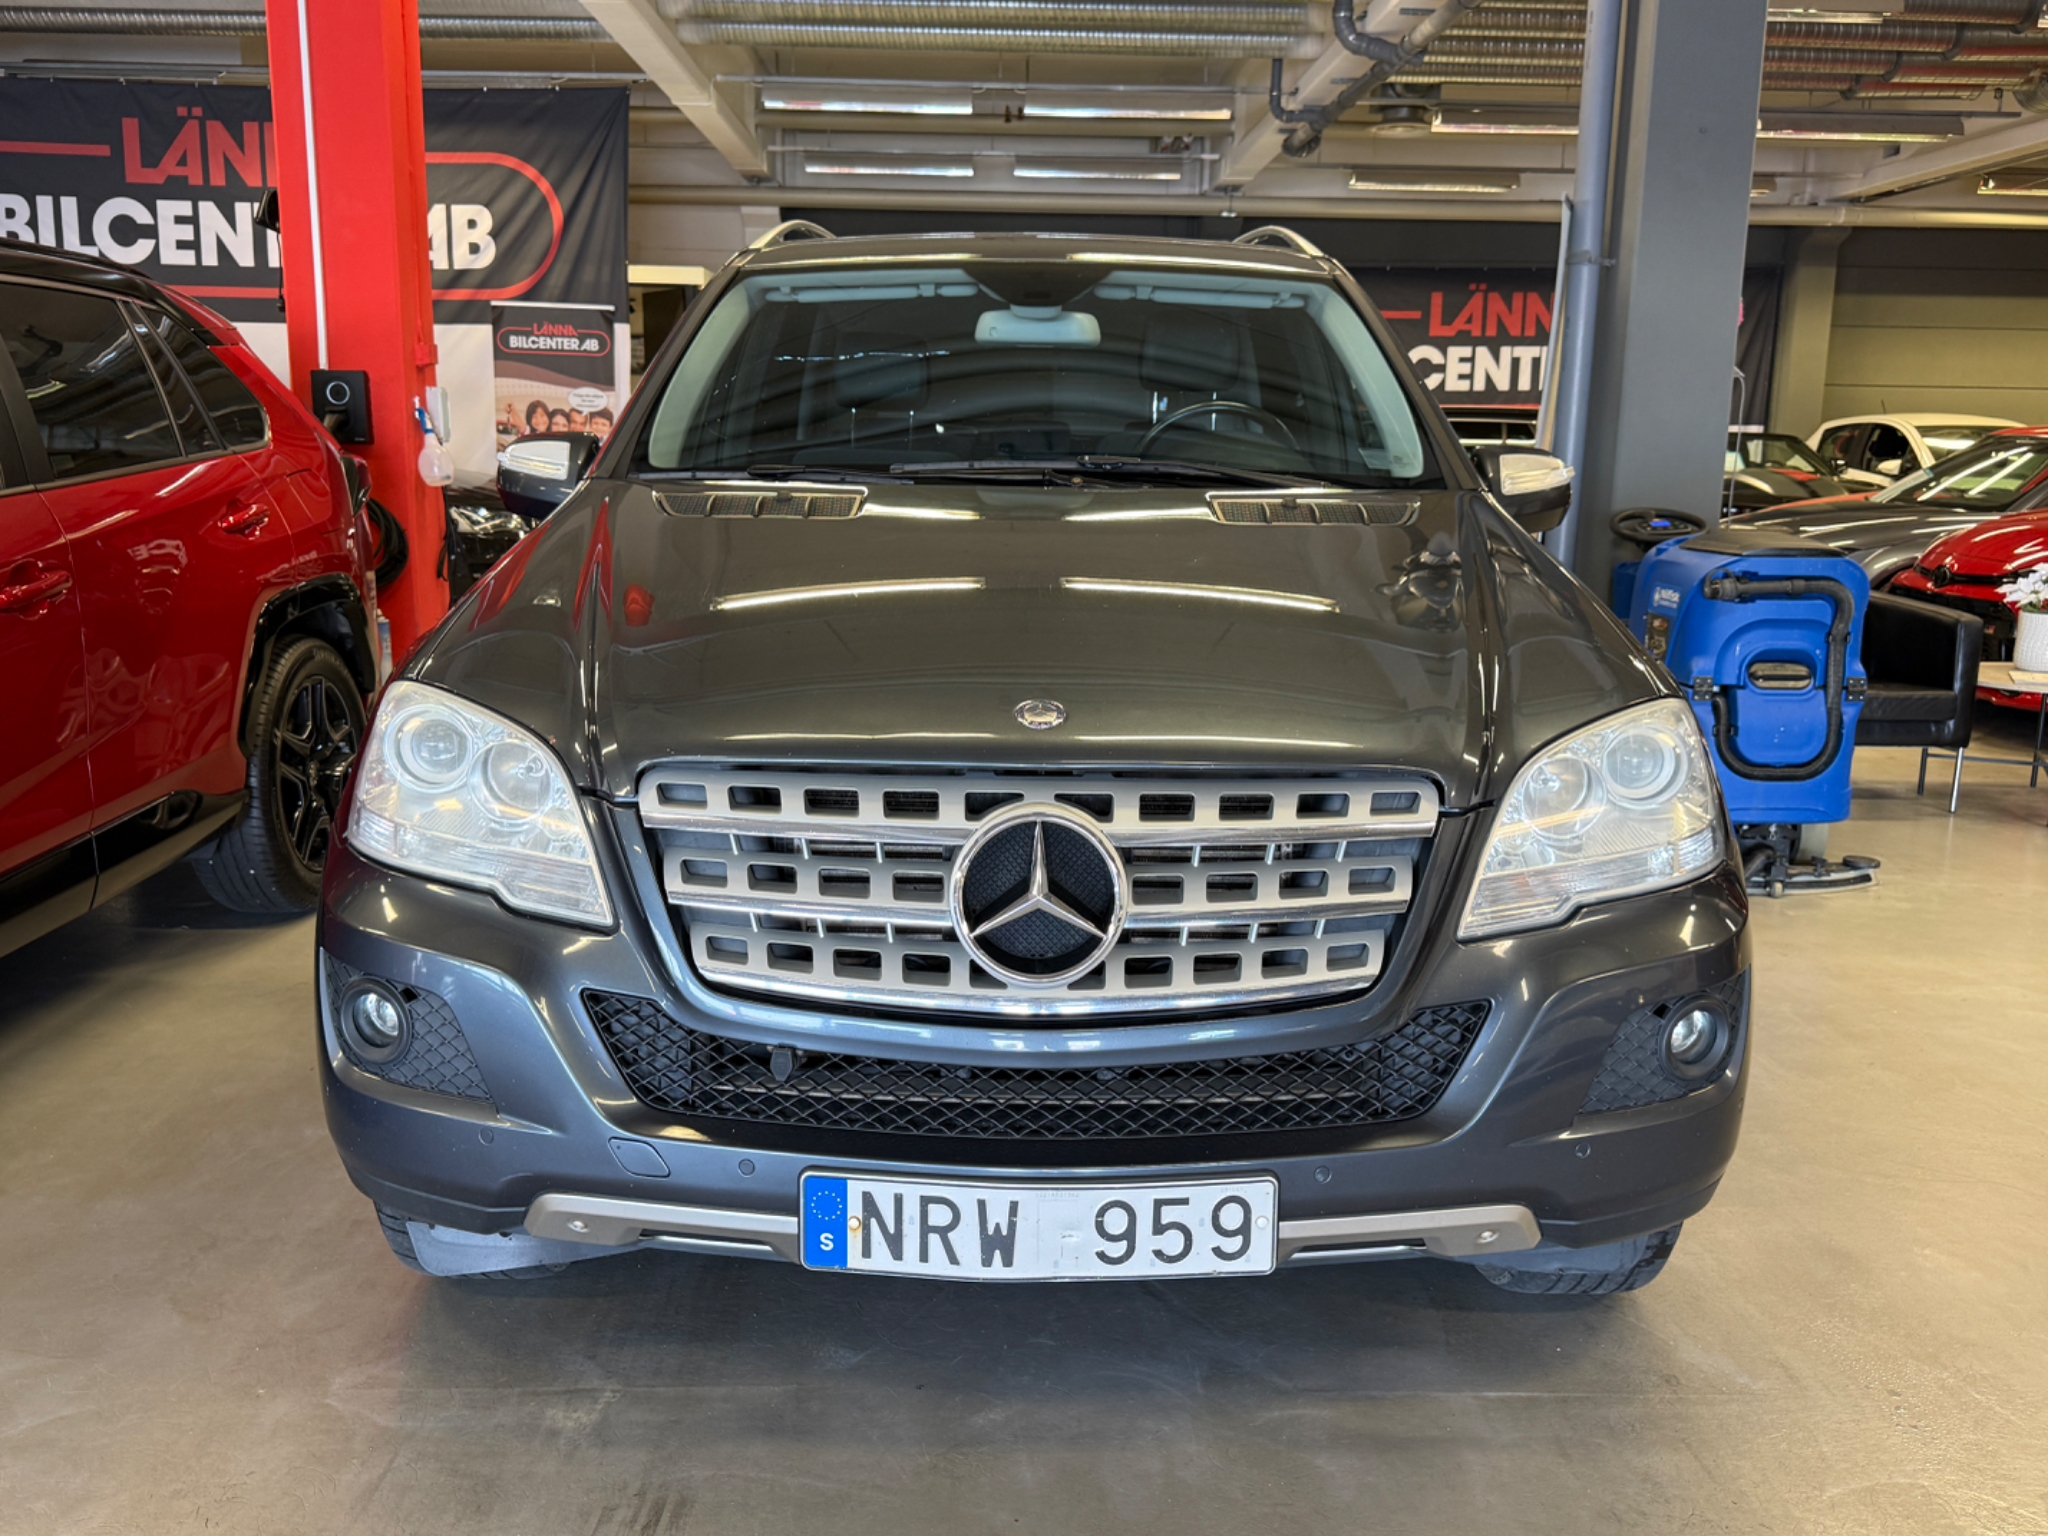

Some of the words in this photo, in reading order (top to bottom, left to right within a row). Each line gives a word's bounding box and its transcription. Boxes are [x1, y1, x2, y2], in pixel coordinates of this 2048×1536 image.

[122, 106, 279, 187] LÄN
[509, 335, 580, 351] BILCENTER
[580, 338, 599, 352] AB
[533, 321, 579, 337] LÄNNA
[1407, 345, 1549, 392] CENT
[819, 1232, 834, 1251] S
[861, 1190, 1019, 1268] NRW
[1094, 1195, 1252, 1266] 959
